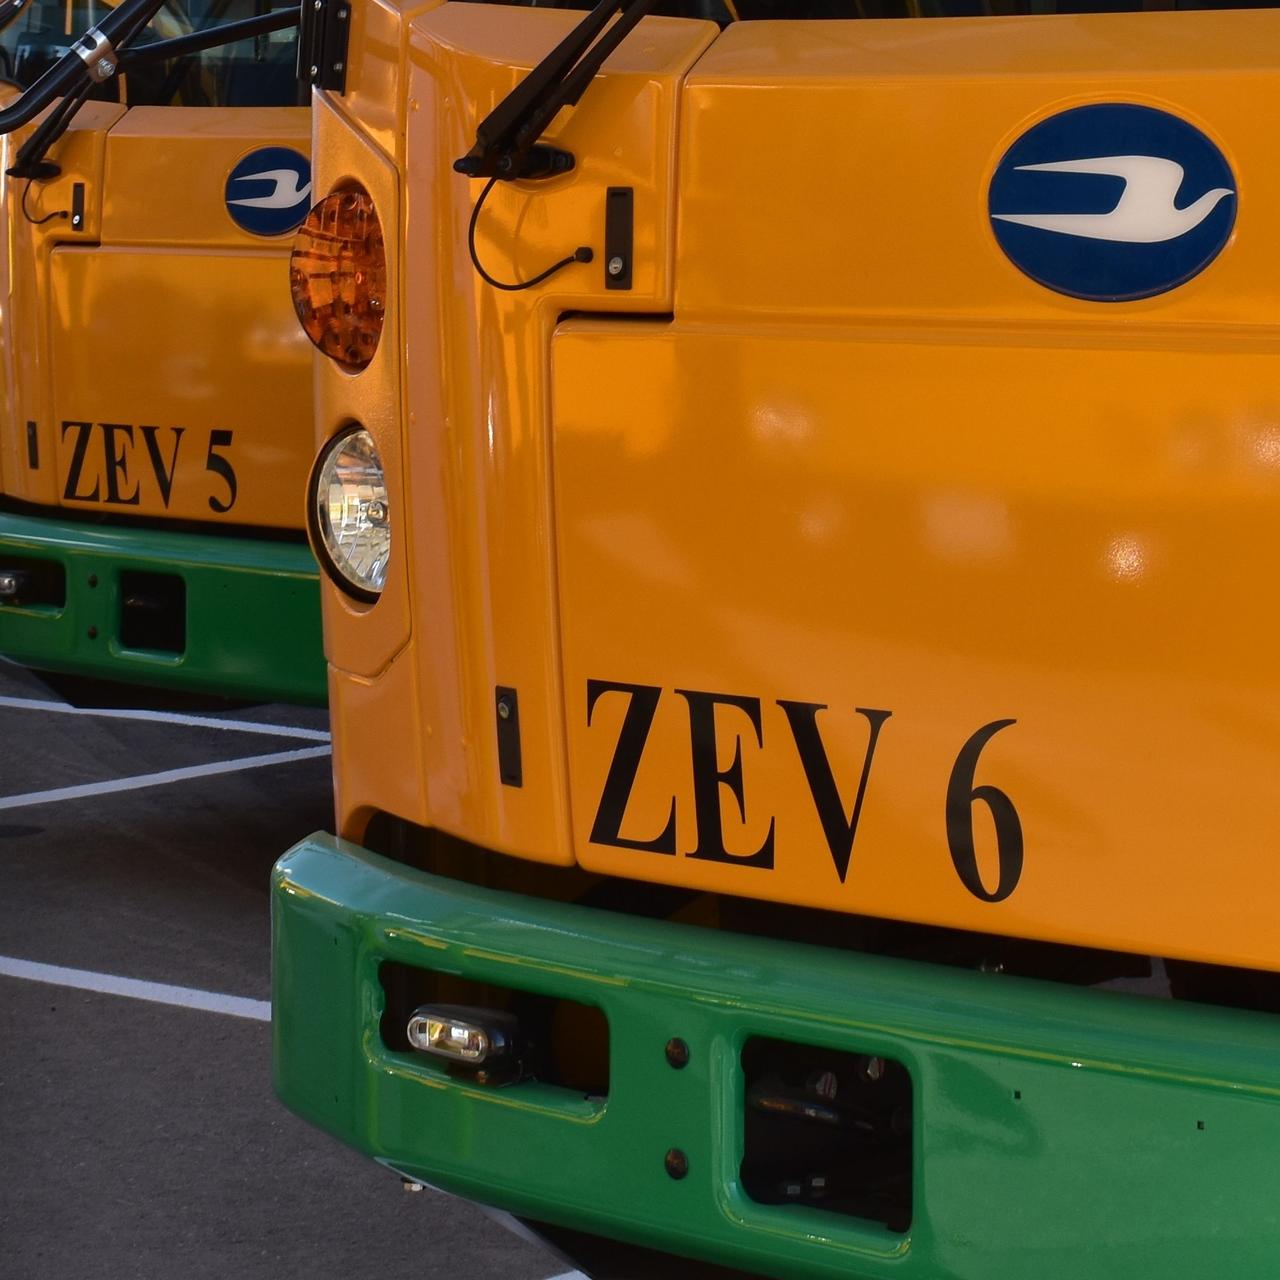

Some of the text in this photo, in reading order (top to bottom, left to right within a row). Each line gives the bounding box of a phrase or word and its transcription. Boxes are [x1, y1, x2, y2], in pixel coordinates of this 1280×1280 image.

[61, 421, 238, 513] ZEV 5
[587, 679, 1024, 904] ZEV 6
